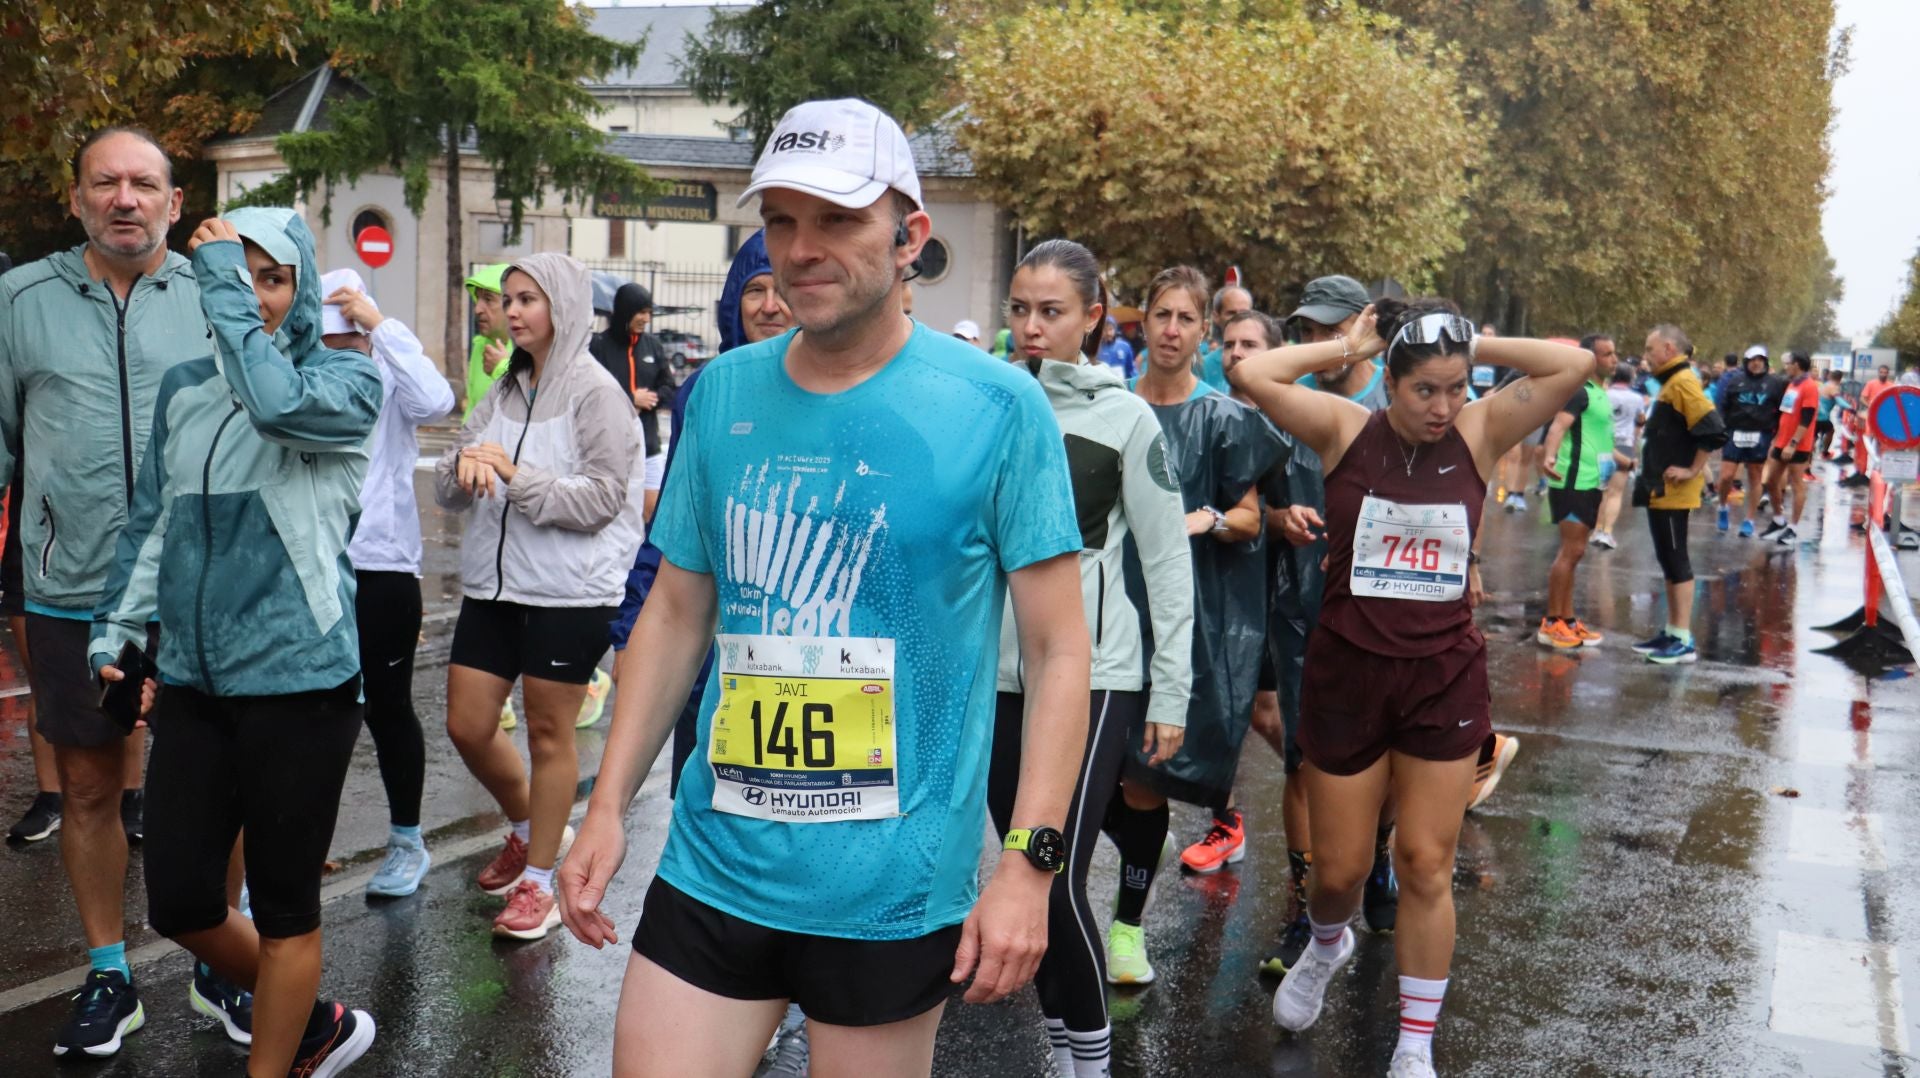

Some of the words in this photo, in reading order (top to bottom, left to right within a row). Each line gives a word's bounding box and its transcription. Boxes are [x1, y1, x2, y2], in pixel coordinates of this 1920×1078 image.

[771, 130, 831, 155] fast
[646, 206, 710, 220] MUNICIPAL
[1382, 535, 1442, 571] 746
[1393, 582, 1445, 593] HYUNDAI
[747, 645, 754, 661] k
[840, 647, 851, 664] k
[840, 666, 886, 674] kutxabank
[775, 682, 808, 697] JAVI
[750, 700, 836, 768] 146
[770, 791, 861, 808] HYUNDAI
[772, 807, 806, 816] Lemauto
[808, 806, 862, 816] Automoción
